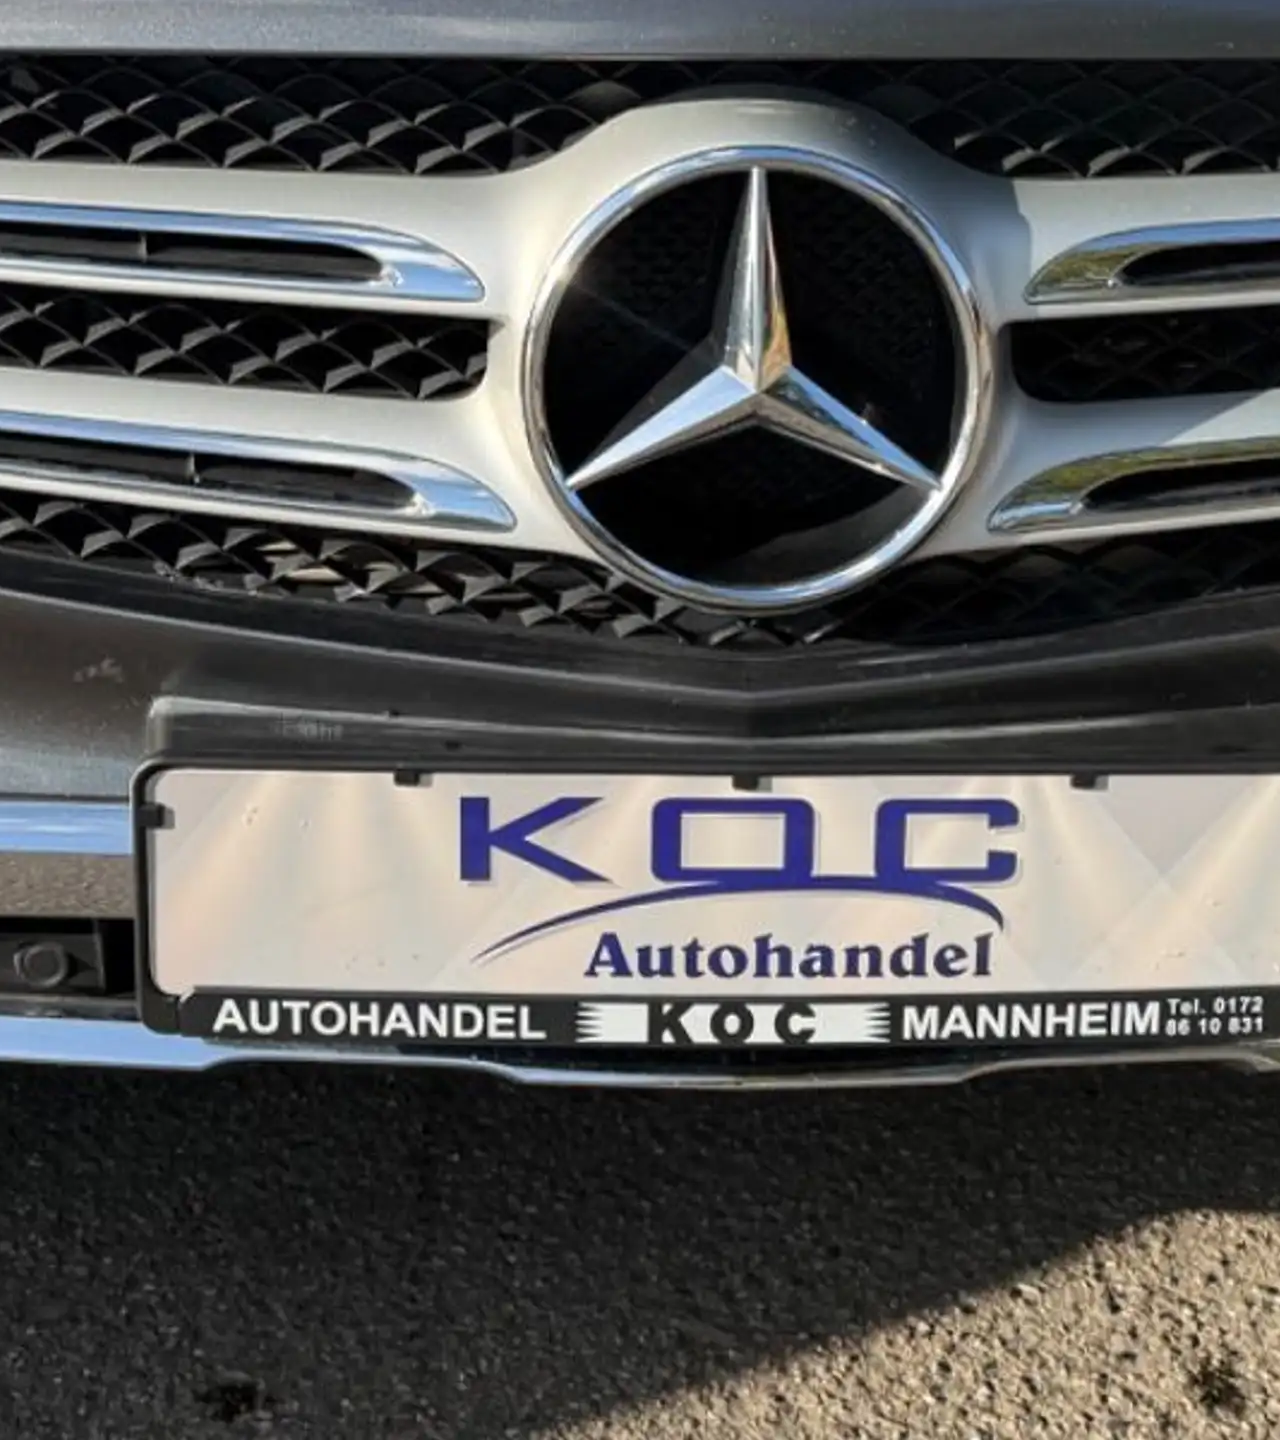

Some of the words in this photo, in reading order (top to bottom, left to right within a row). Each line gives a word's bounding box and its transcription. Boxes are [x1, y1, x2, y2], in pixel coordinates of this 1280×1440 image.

[583, 931, 995, 979] Autohandel
[212, 998, 547, 1040] AUTOHANDEL
[647, 1003, 818, 1044] KOC
[902, 1000, 1160, 1041] MANNHEIM
[1166, 997, 1207, 1017] Tel.
[1213, 995, 1264, 1015] 0172
[1198, 1017, 1222, 1036] 10
